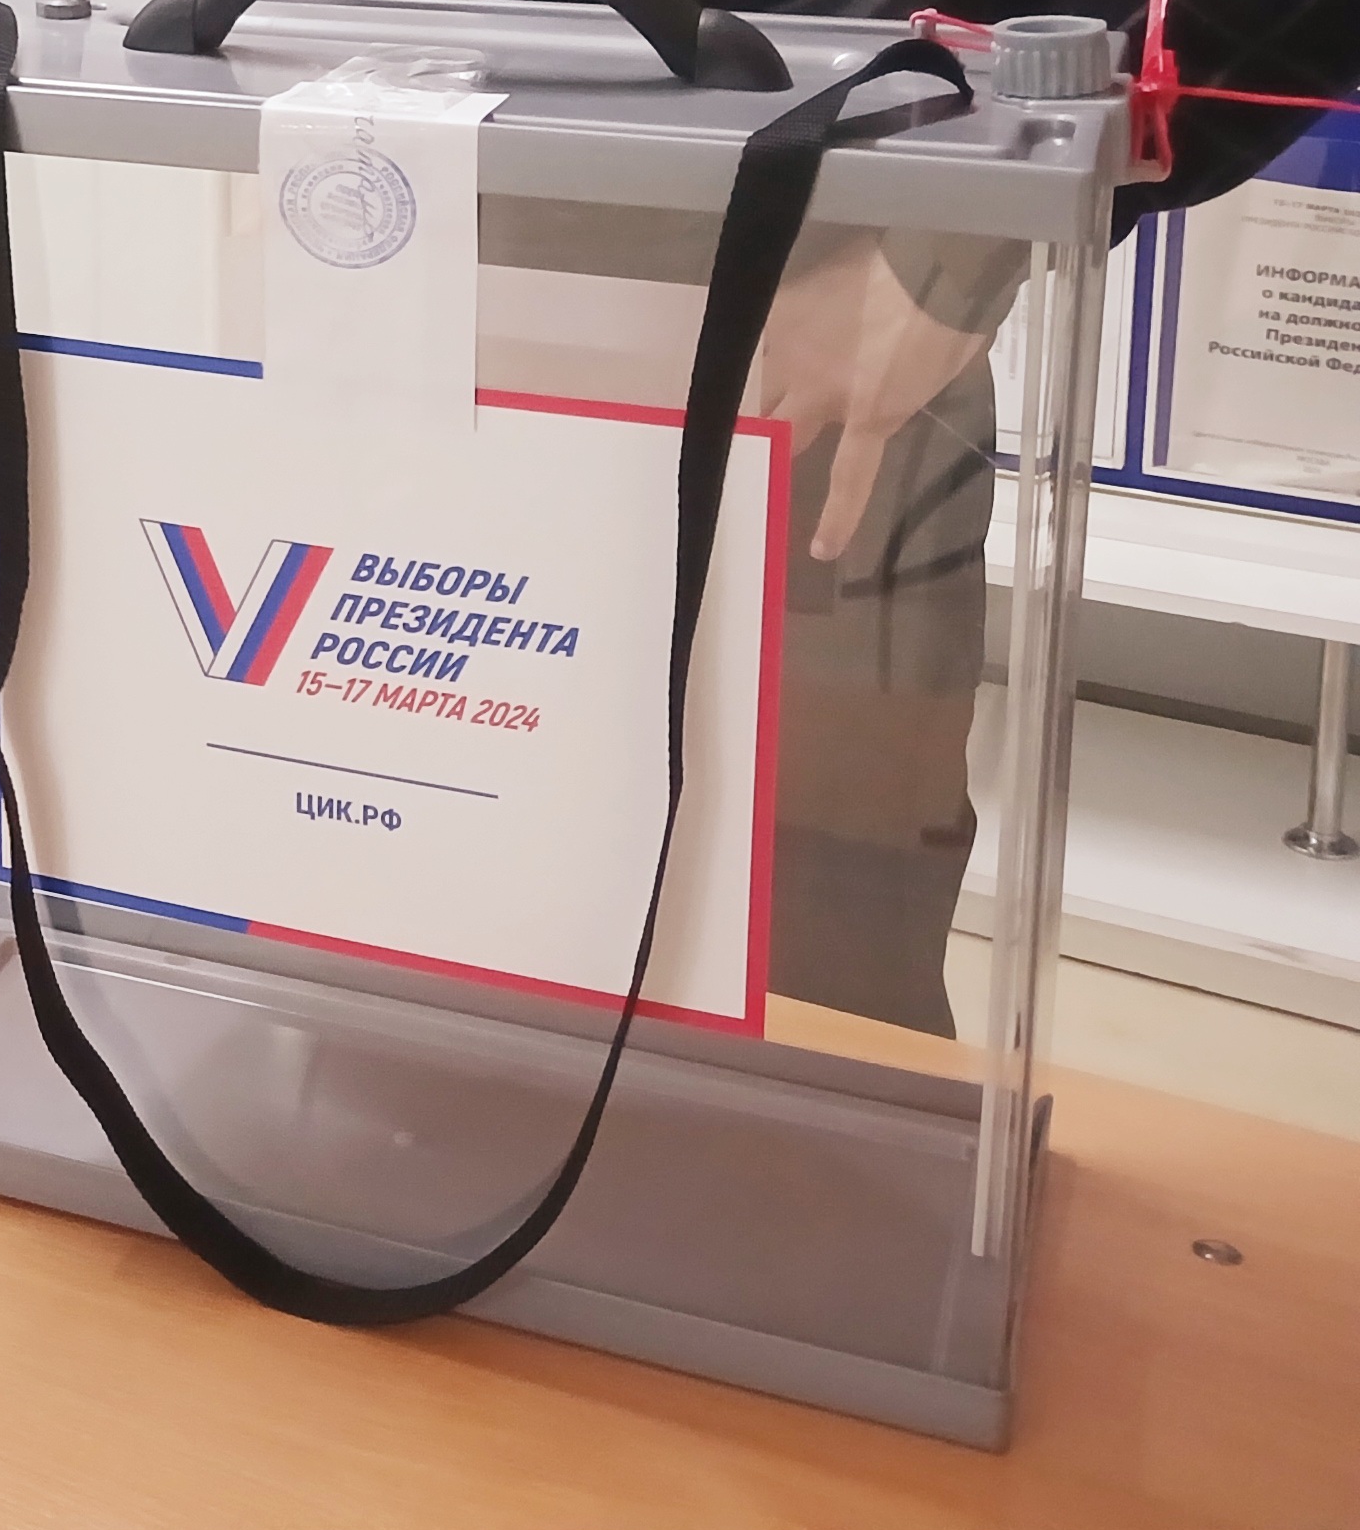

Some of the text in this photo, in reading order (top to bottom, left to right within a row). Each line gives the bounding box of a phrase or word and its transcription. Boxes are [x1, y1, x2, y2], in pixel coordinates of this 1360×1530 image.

[1256, 263, 1360, 289] ИНФОРМА
[1258, 309, 1281, 321] на
[1208, 341, 1320, 368] Российской
[350, 553, 529, 605] ВЫБОРЫ
[330, 593, 580, 658] ПРЕЗИДЕНТА
[310, 632, 470, 682] РОССИИ
[372, 683, 468, 721] МАРТА
[470, 699, 541, 732] 2024
[295, 791, 402, 833] ЦИК.РФ
